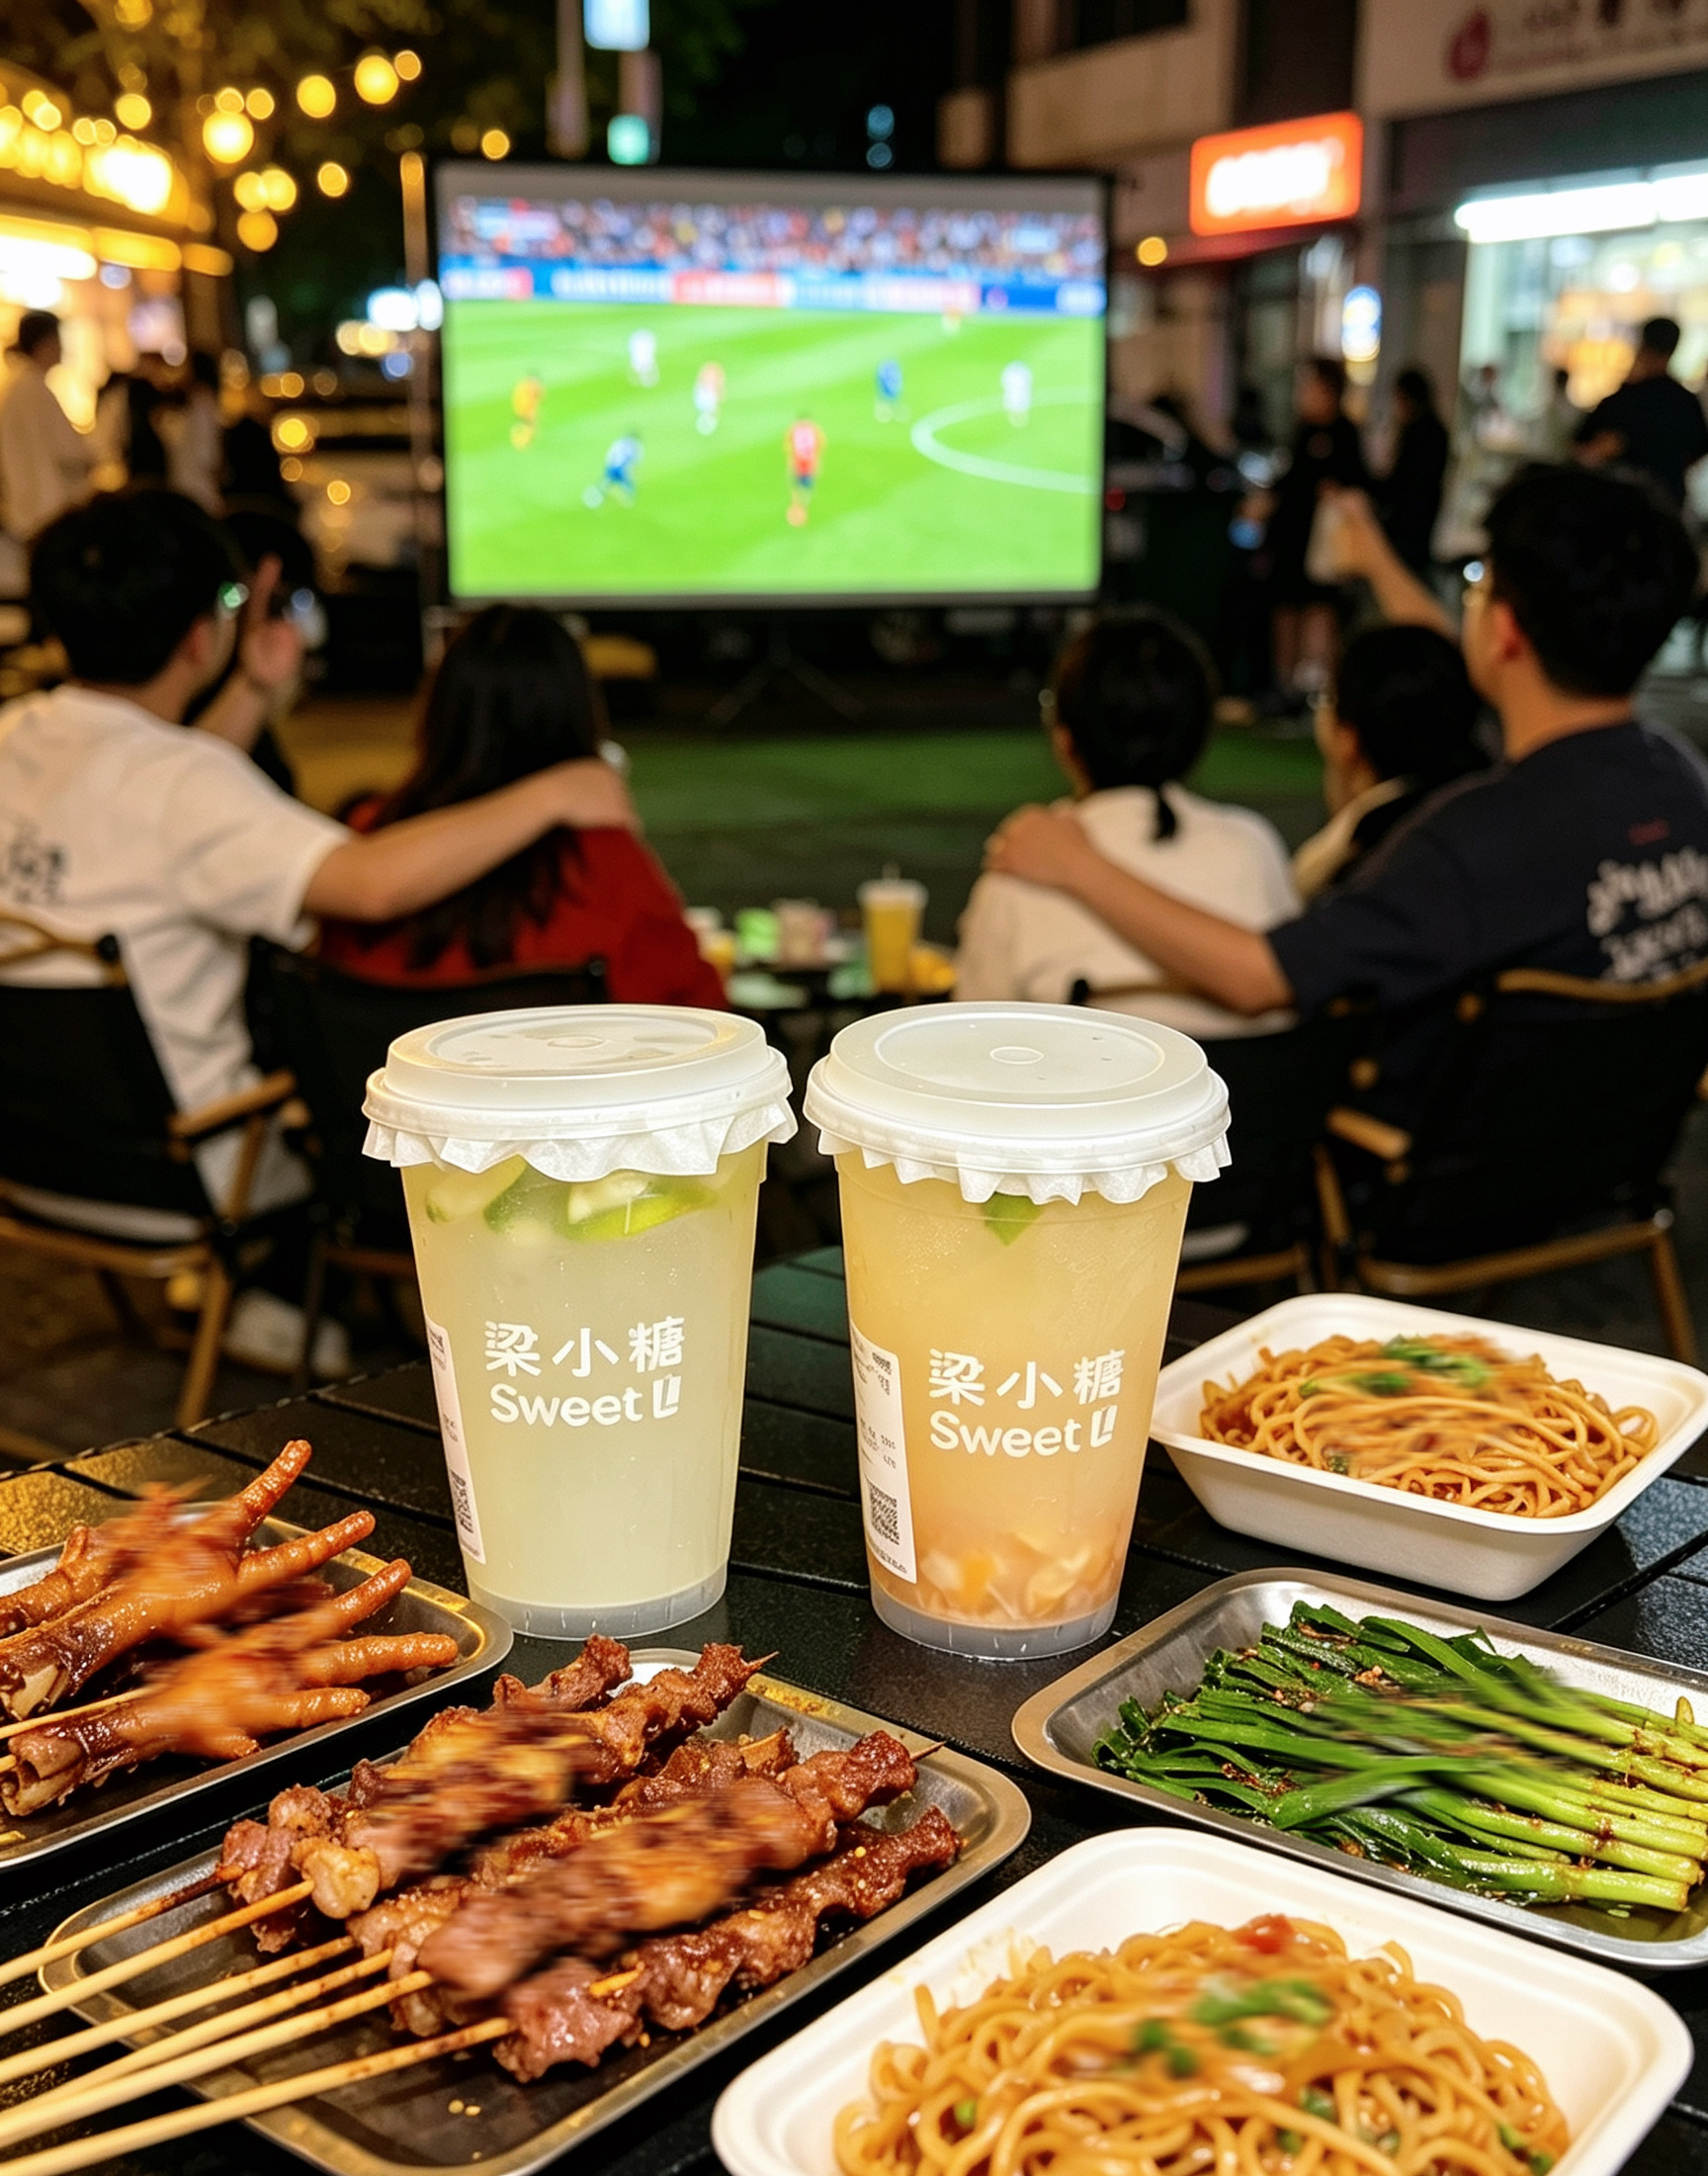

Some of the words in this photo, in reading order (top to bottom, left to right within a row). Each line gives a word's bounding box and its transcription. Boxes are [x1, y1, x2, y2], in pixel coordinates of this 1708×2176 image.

[484, 1315, 685, 1378] 梁小糖
[489, 1383, 643, 1428] Sweet
[928, 1348, 1126, 1409] 梁小糖
[929, 1410, 1082, 1457] Sweet
